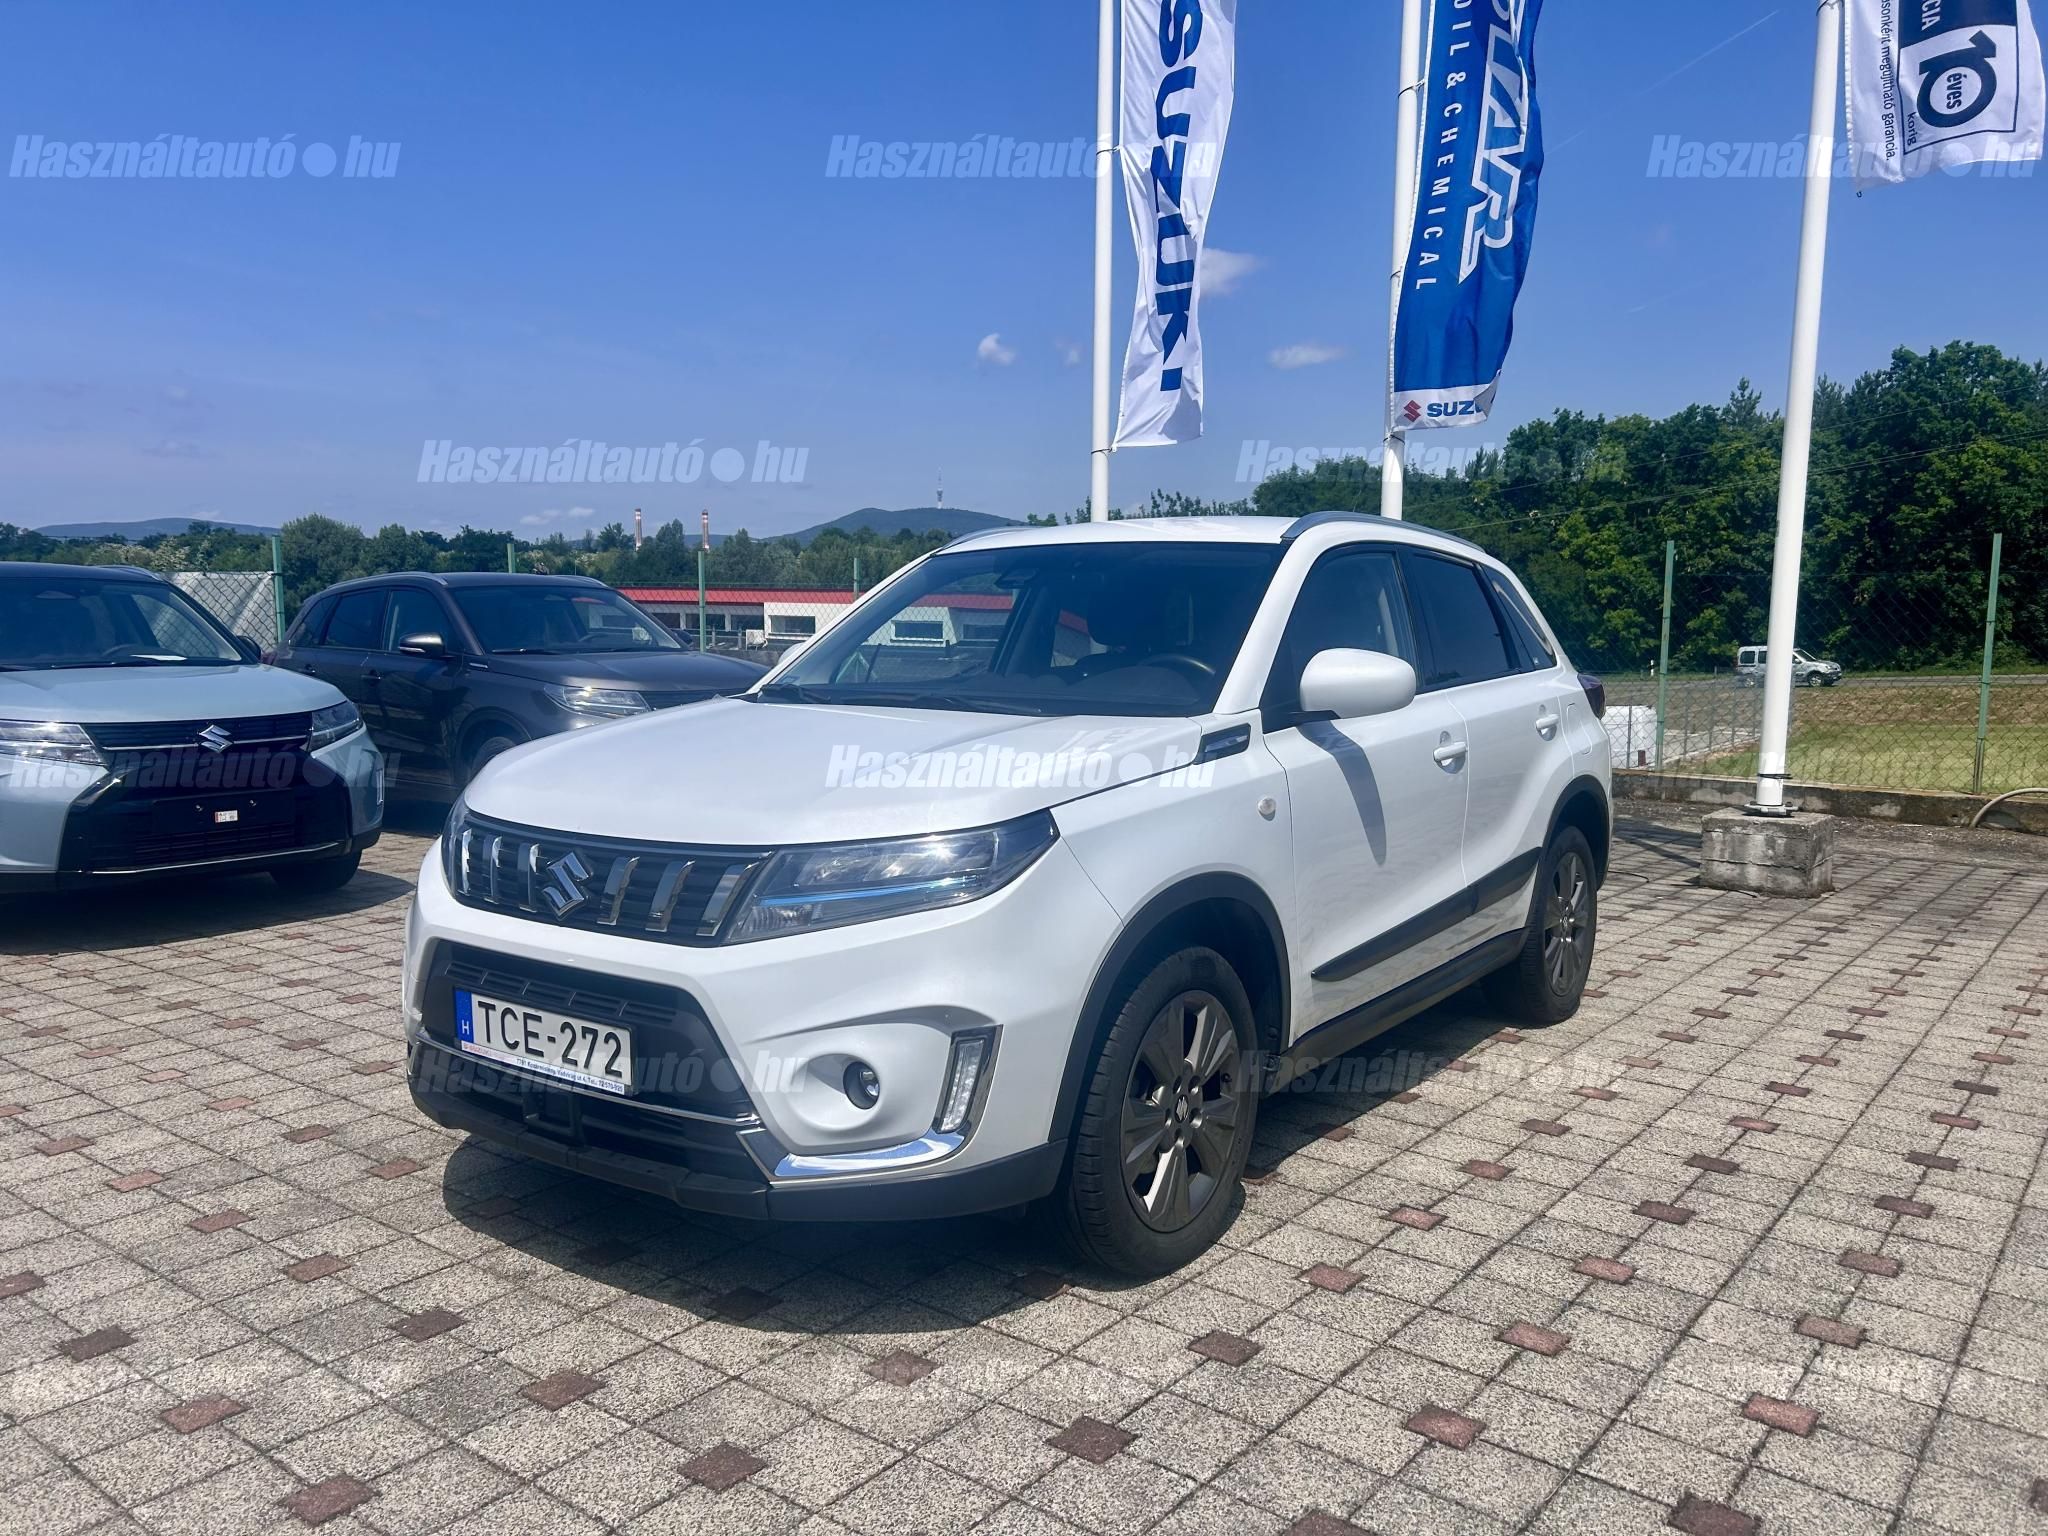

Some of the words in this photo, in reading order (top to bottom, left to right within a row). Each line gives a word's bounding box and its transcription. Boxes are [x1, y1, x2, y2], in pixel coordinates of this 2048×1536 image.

[1446, 71, 1466, 90] &
[1946, 73, 1967, 110] éves
[1882, 112, 1898, 161] garancia.
[1151, 0, 1203, 391] SUZUKI
[1416, 102, 1463, 290] CHEMICAL
[1426, 401, 1484, 418] SUZ
[462, 1019, 470, 1035] H
[477, 1000, 623, 1078] TCE-272
